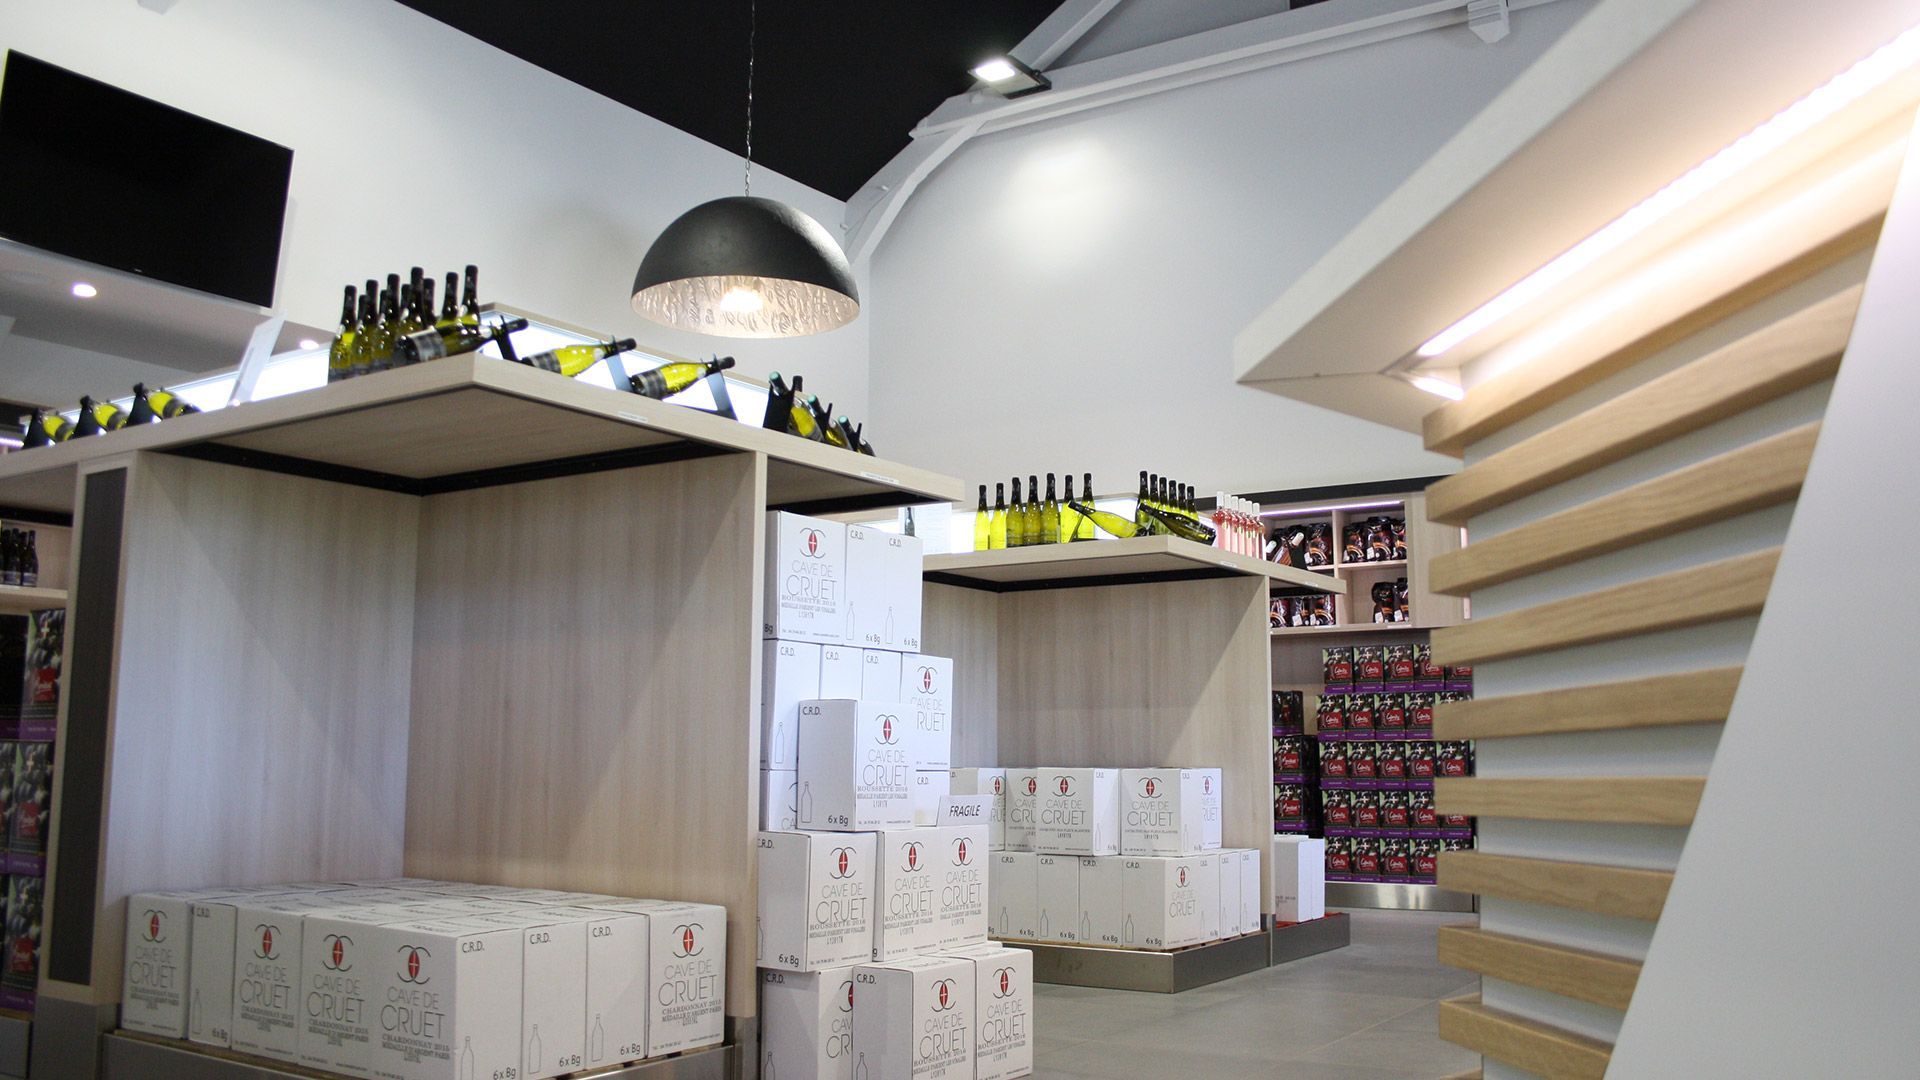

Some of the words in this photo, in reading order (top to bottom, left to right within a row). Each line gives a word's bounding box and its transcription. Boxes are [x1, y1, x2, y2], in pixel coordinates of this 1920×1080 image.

[792, 561, 818, 576] CAVE
[820, 565, 833, 577] DE
[787, 575, 837, 601] CRUET
[803, 707, 822, 717] C.R.D.
[918, 712, 946, 732] RUET
[868, 750, 892, 763] CAVE
[893, 751, 905, 763] DE
[863, 765, 909, 787] CRUET
[949, 804, 981, 817] FRAGILE
[1046, 800, 1068, 809] CAVE
[1070, 800, 1083, 809] DE
[1132, 801, 1155, 810] CAVE
[1157, 801, 1169, 811] DE
[1042, 810, 1087, 825] CRUET
[1127, 811, 1175, 827] CRUET
[896, 877, 917, 891] CAVE
[919, 876, 931, 889] DE
[947, 871, 966, 884] CAVE
[968, 870, 978, 882] DE
[822, 884, 849, 899] CAVE
[851, 883, 863, 896] DE
[942, 883, 983, 907] CRUET
[816, 898, 868, 924] CRUET
[891, 890, 934, 916] CRUET
[1170, 900, 1197, 919] CRUET
[530, 933, 552, 945] C.R.D.
[593, 927, 613, 938] C.R.D.
[462, 941, 485, 954] C.R.D.
[130, 961, 177, 988] CRUET
[665, 962, 695, 980] CAVE
[699, 960, 712, 975] DE
[767, 974, 786, 985] C.R.D.
[857, 974, 877, 985] C.R.D.
[240, 979, 292, 1010] CRUET
[314, 975, 343, 993] CAVE
[346, 978, 361, 996] DE
[659, 975, 718, 1007] CRUET
[307, 992, 365, 1024] CRUET
[388, 987, 420, 1007] CAVE
[424, 992, 440, 1010] DE
[663, 1003, 707, 1015] CHARDONNAY
[988, 1002, 1009, 1019] CAVE
[1011, 999, 1023, 1014] DE
[381, 1005, 446, 1039] CRUET
[832, 1018, 852, 1033] CAV
[925, 1016, 949, 1034] CAVE
[951, 1012, 963, 1027] DE
[983, 1013, 1027, 1044] CRUET
[920, 1027, 968, 1060] CRUET
